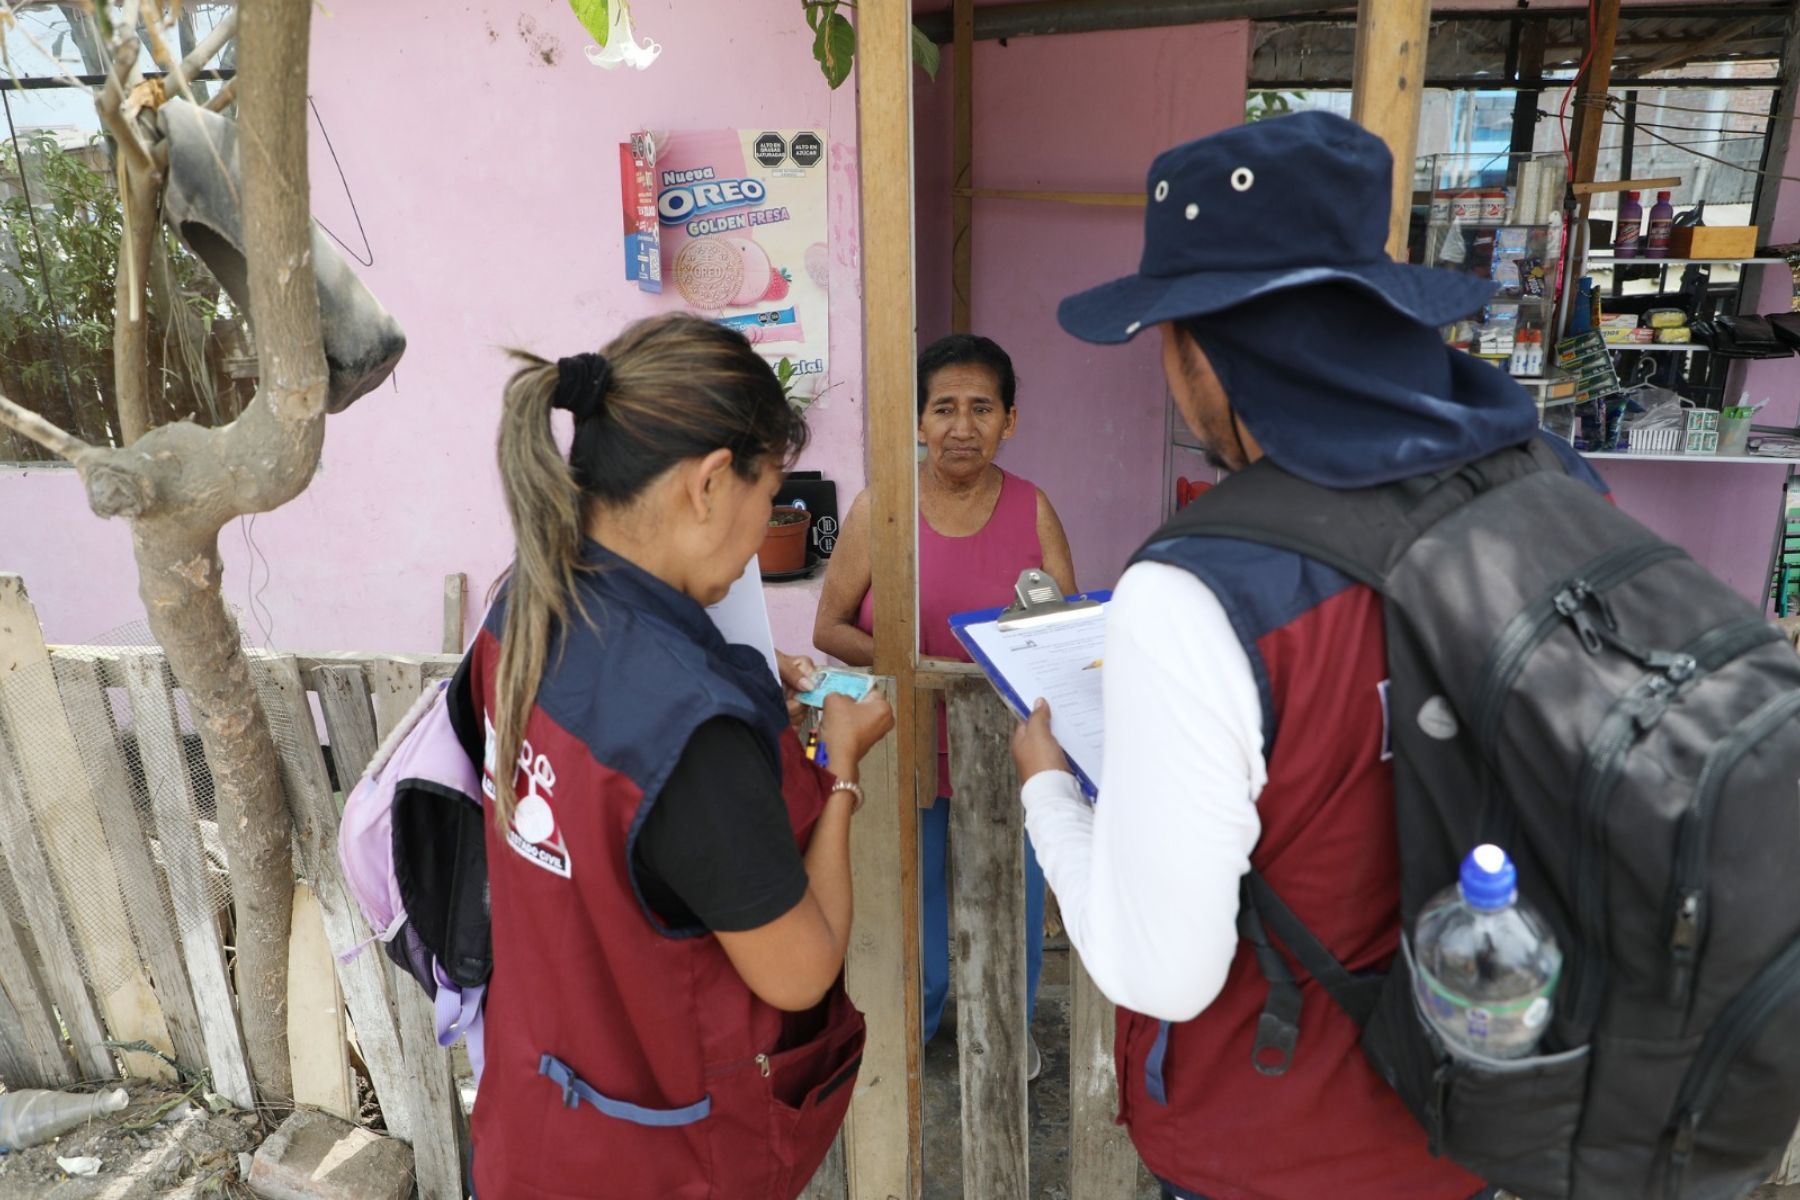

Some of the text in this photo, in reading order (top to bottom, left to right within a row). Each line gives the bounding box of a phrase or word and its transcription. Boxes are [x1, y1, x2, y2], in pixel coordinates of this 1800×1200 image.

[663, 166, 715, 186] Nueva
[658, 180, 763, 218] OREO
[687, 207, 790, 237] GOLDEN FRESA
[539, 849, 564, 869] CIVIL
